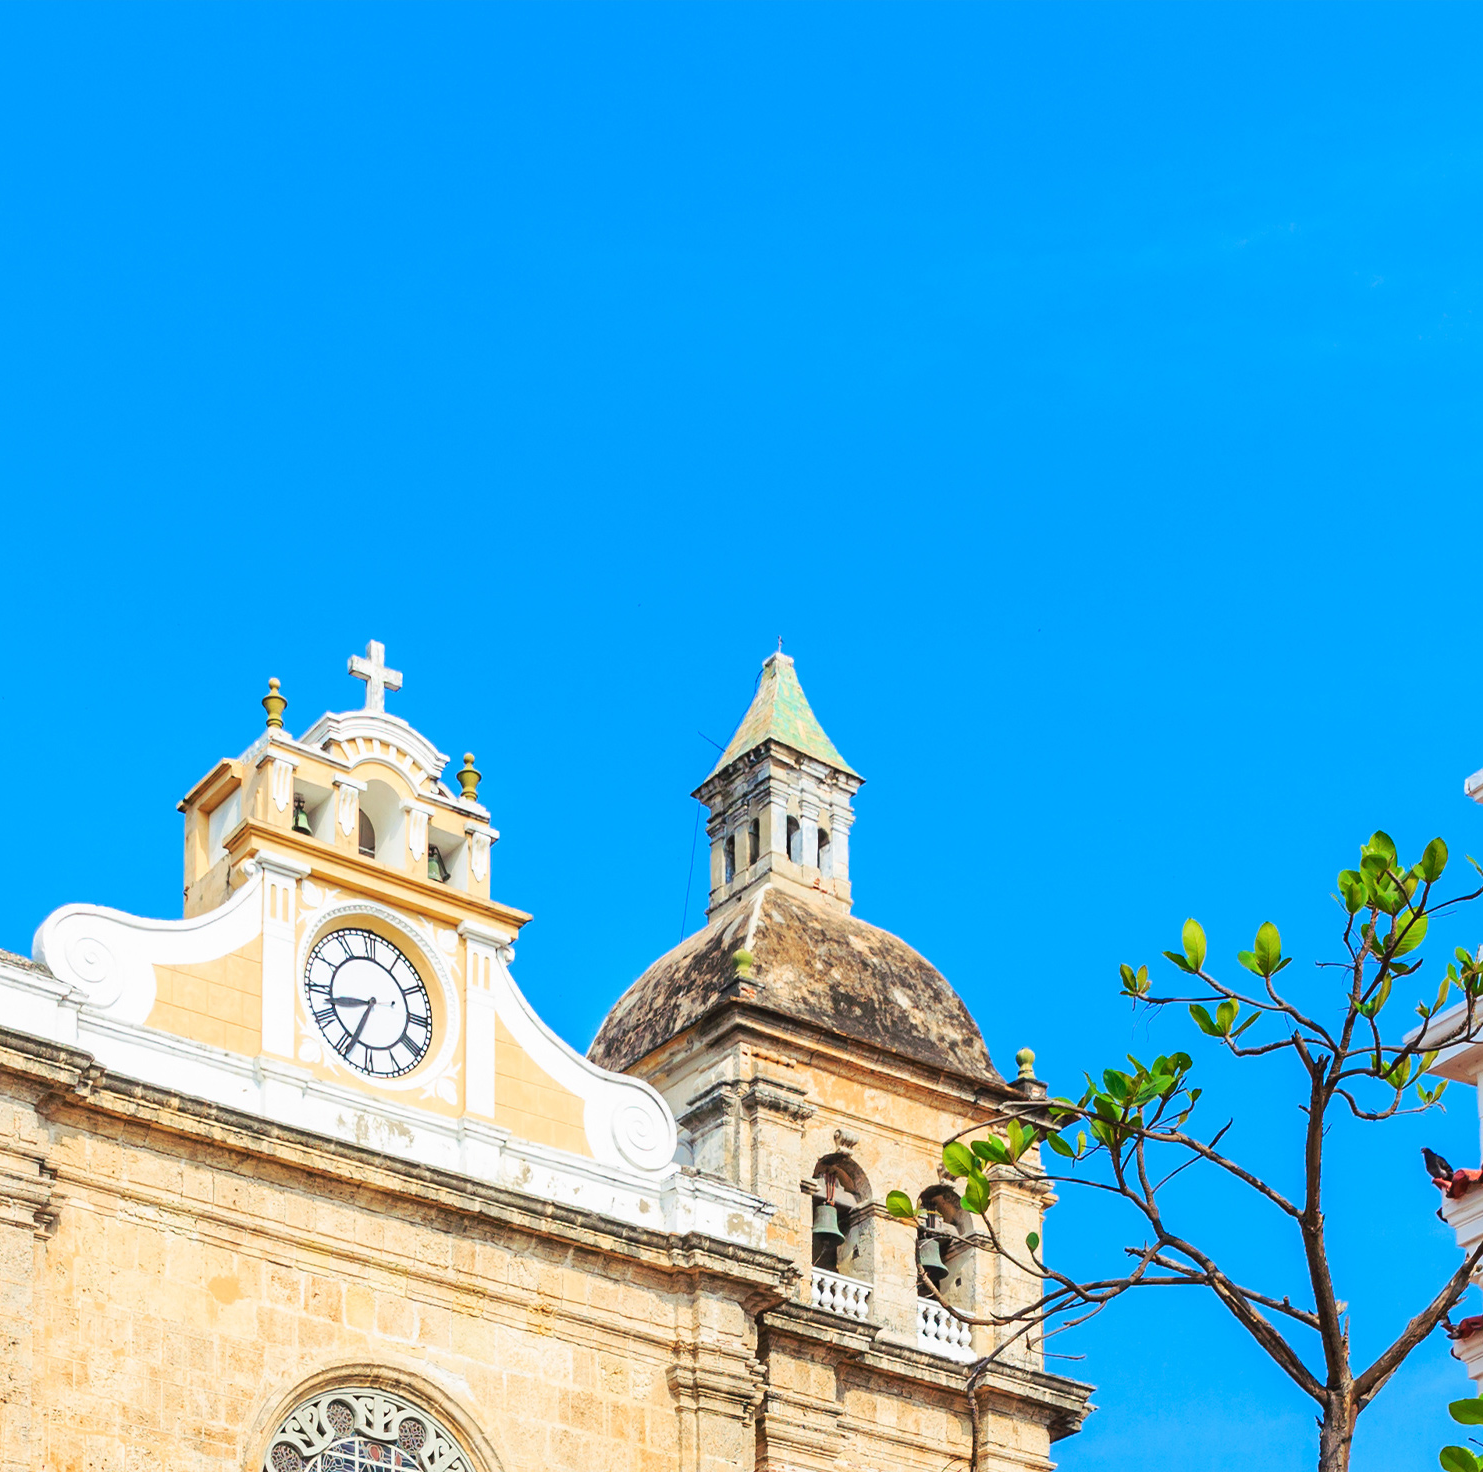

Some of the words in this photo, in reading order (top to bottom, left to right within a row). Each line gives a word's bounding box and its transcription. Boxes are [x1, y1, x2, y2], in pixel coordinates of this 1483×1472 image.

[336, 935, 354, 960] XI
[363, 936, 376, 961] XII
[315, 950, 338, 972] X
[308, 979, 332, 996] IX
[401, 984, 422, 996] II
[406, 1012, 428, 1029] III
[388, 1048, 402, 1072] V
